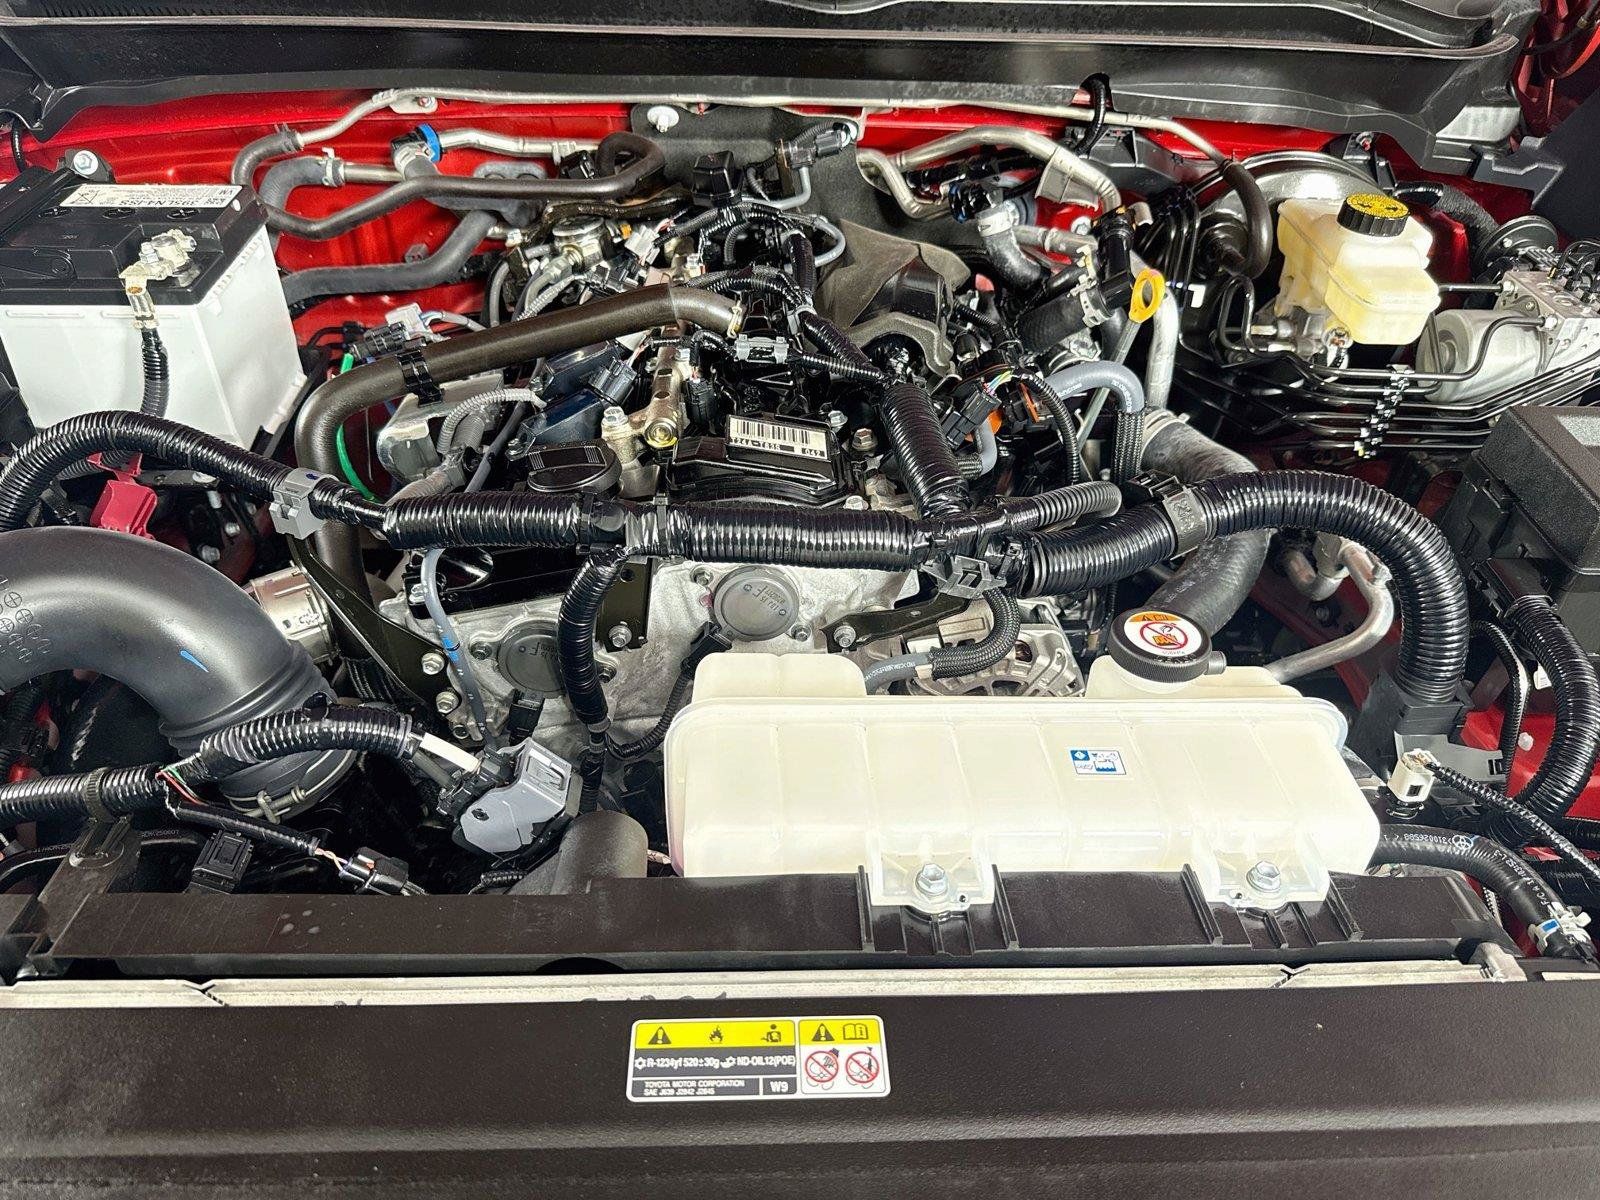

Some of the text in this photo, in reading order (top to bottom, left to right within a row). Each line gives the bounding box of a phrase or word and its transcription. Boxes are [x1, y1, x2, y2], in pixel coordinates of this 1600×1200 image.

[672, 1080, 697, 1088] MOTOR
[698, 1079, 745, 1087] CORPORATION
[770, 1080, 789, 1093] W9
[643, 1088, 658, 1096] SAE
